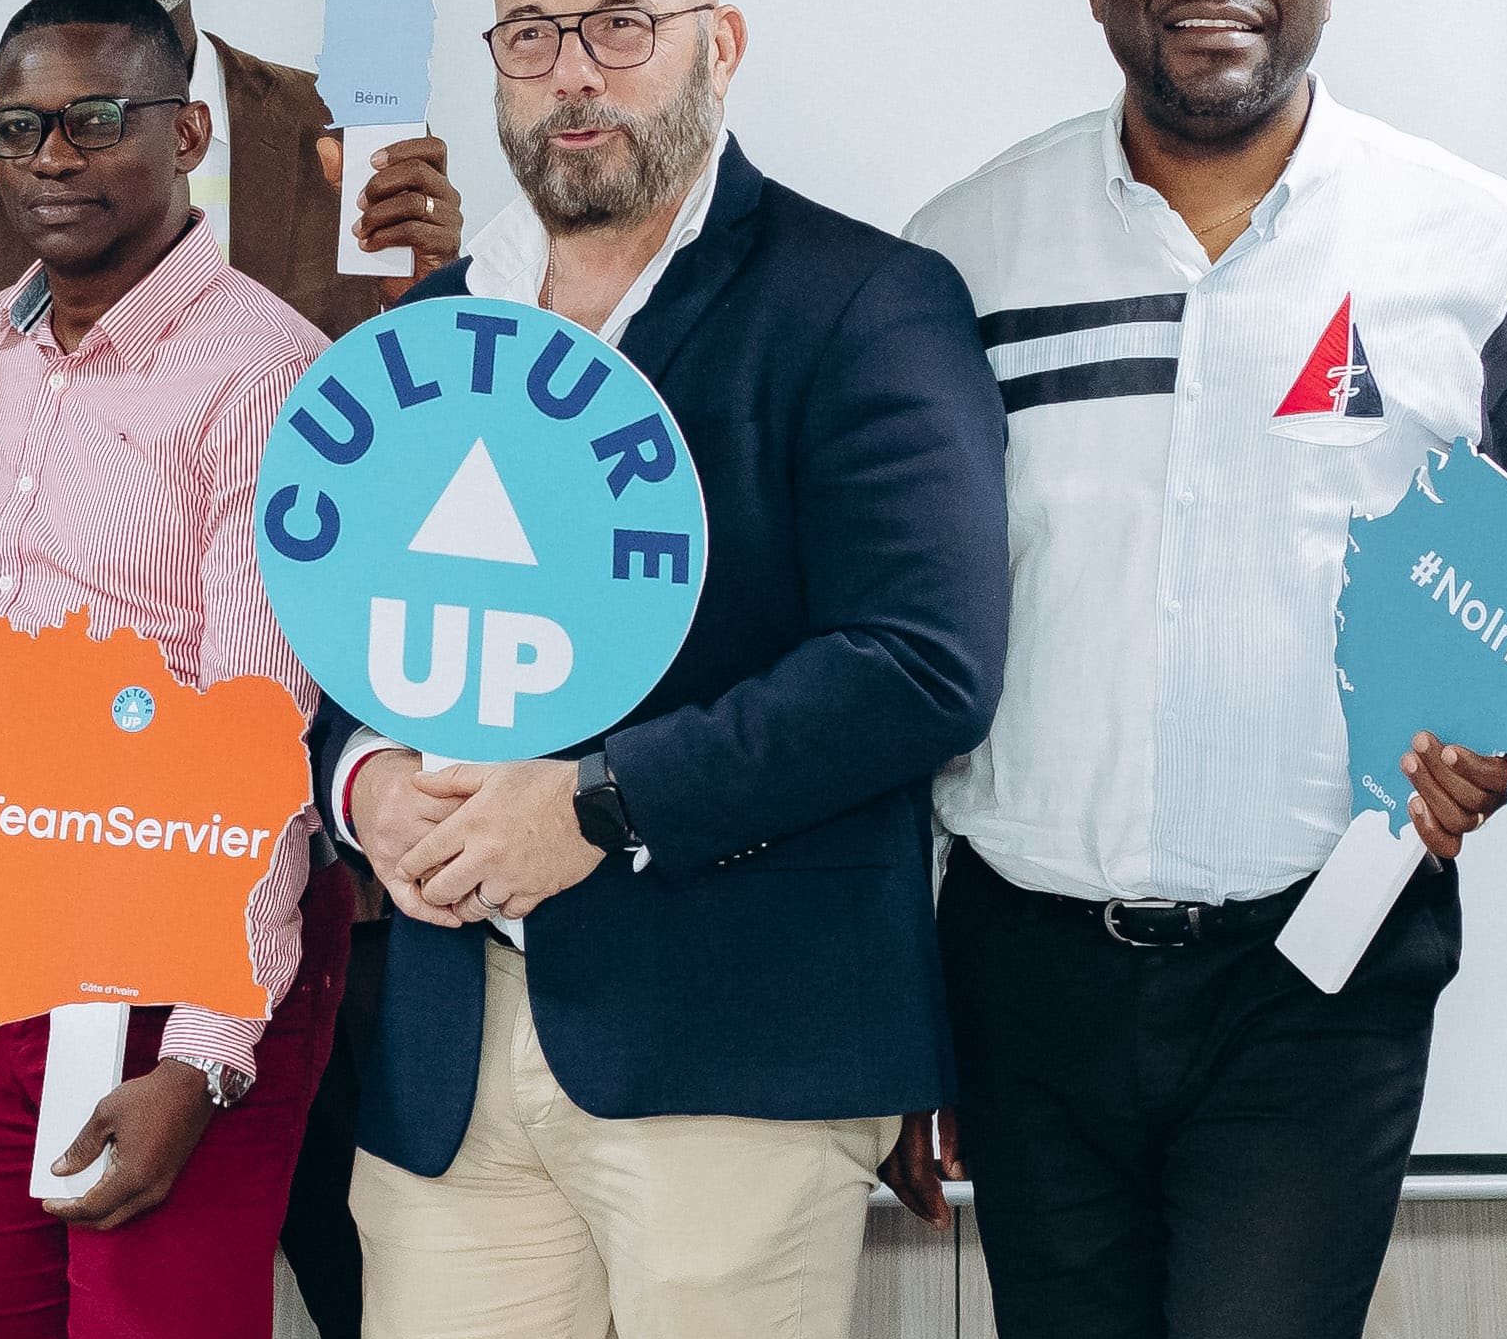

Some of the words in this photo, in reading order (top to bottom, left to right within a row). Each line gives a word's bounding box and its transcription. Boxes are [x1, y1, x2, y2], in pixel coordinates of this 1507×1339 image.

[354, 90, 399, 106] Bénin
[264, 311, 690, 585] CULTURE
[368, 596, 574, 728] UP
[113, 688, 153, 715] CULTURE
[121, 715, 142, 729] UP
[1361, 775, 1397, 810] Gabon
[80, 981, 104, 994] Côte
